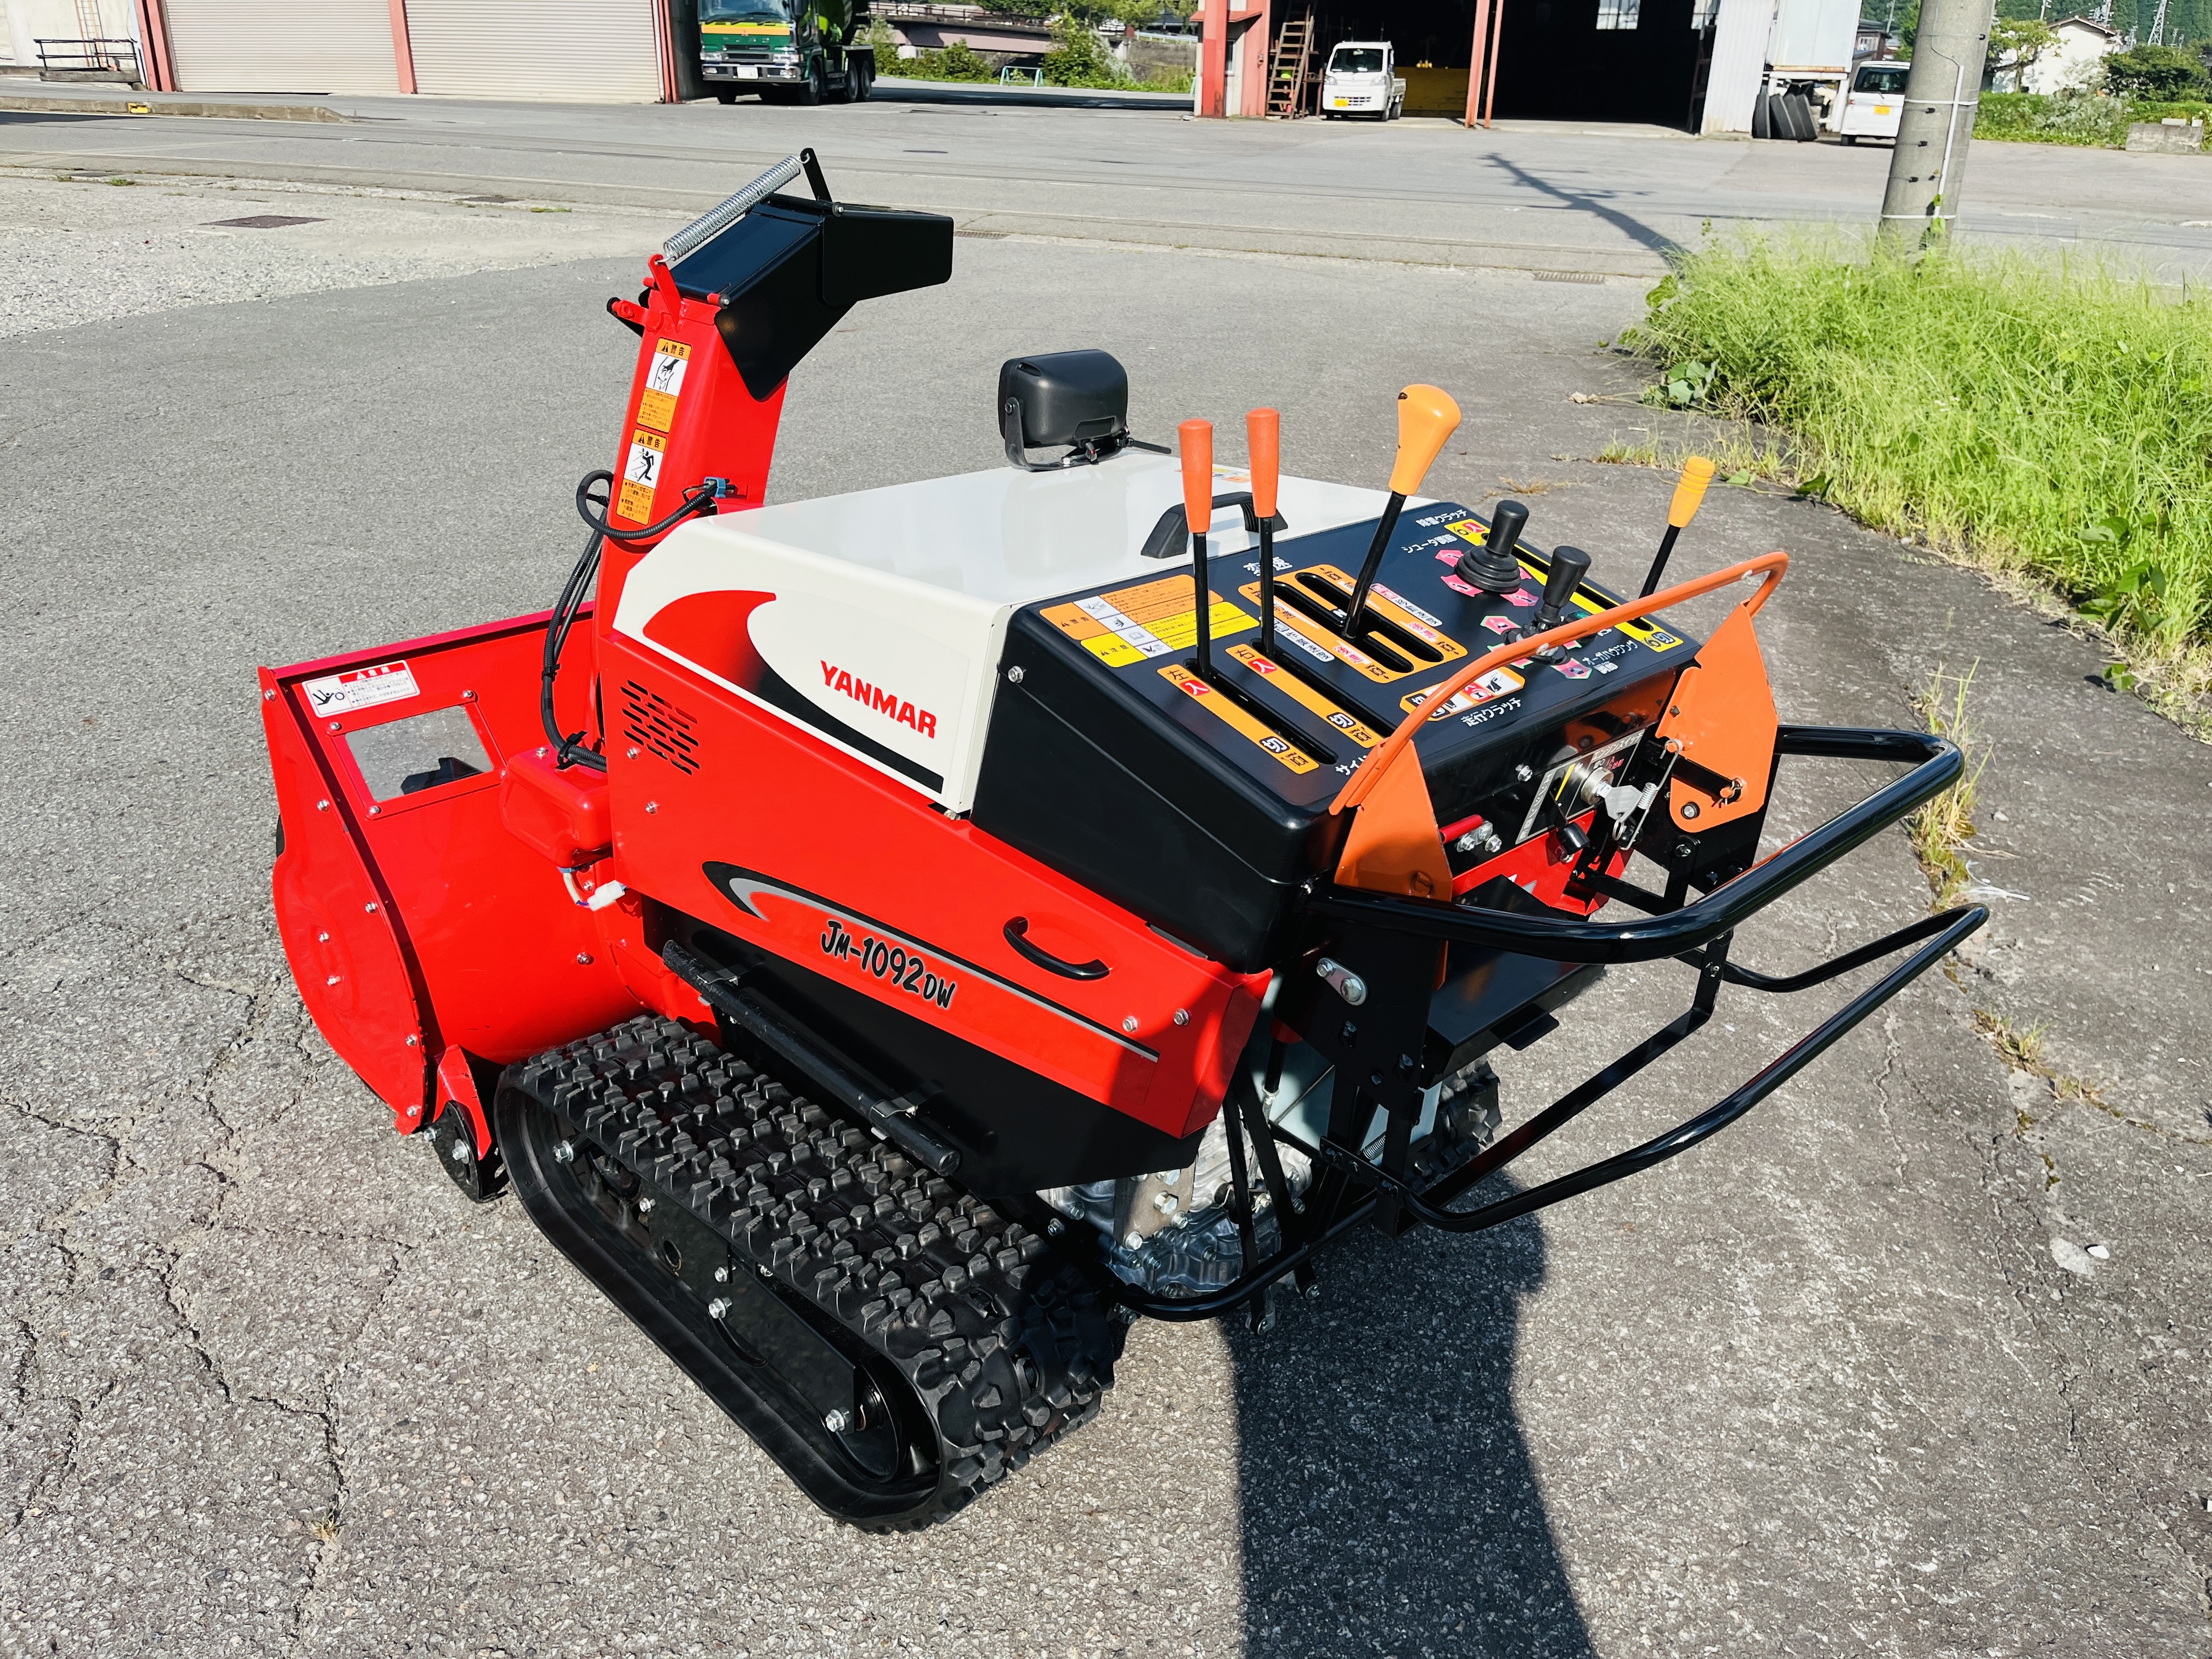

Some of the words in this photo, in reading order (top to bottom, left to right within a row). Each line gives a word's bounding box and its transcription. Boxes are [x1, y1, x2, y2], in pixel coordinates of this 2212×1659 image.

[1465, 523, 1485, 533] 入
[1243, 556, 1293, 577] 変速
[1332, 608, 1347, 618] N
[1655, 631, 1674, 644] 切
[1234, 648, 1256, 660] 右
[1251, 661, 1276, 674] 入
[1166, 669, 1189, 681] 左
[1185, 682, 1209, 696] 入
[820, 659, 937, 739] YANMAR
[1460, 697, 1521, 727] 走行クラッチ
[1329, 713, 1354, 728] 切
[1261, 737, 1288, 753] 切
[1591, 731, 1644, 761] エンジンスイッチ
[821, 919, 956, 1009] JM-1092DW
